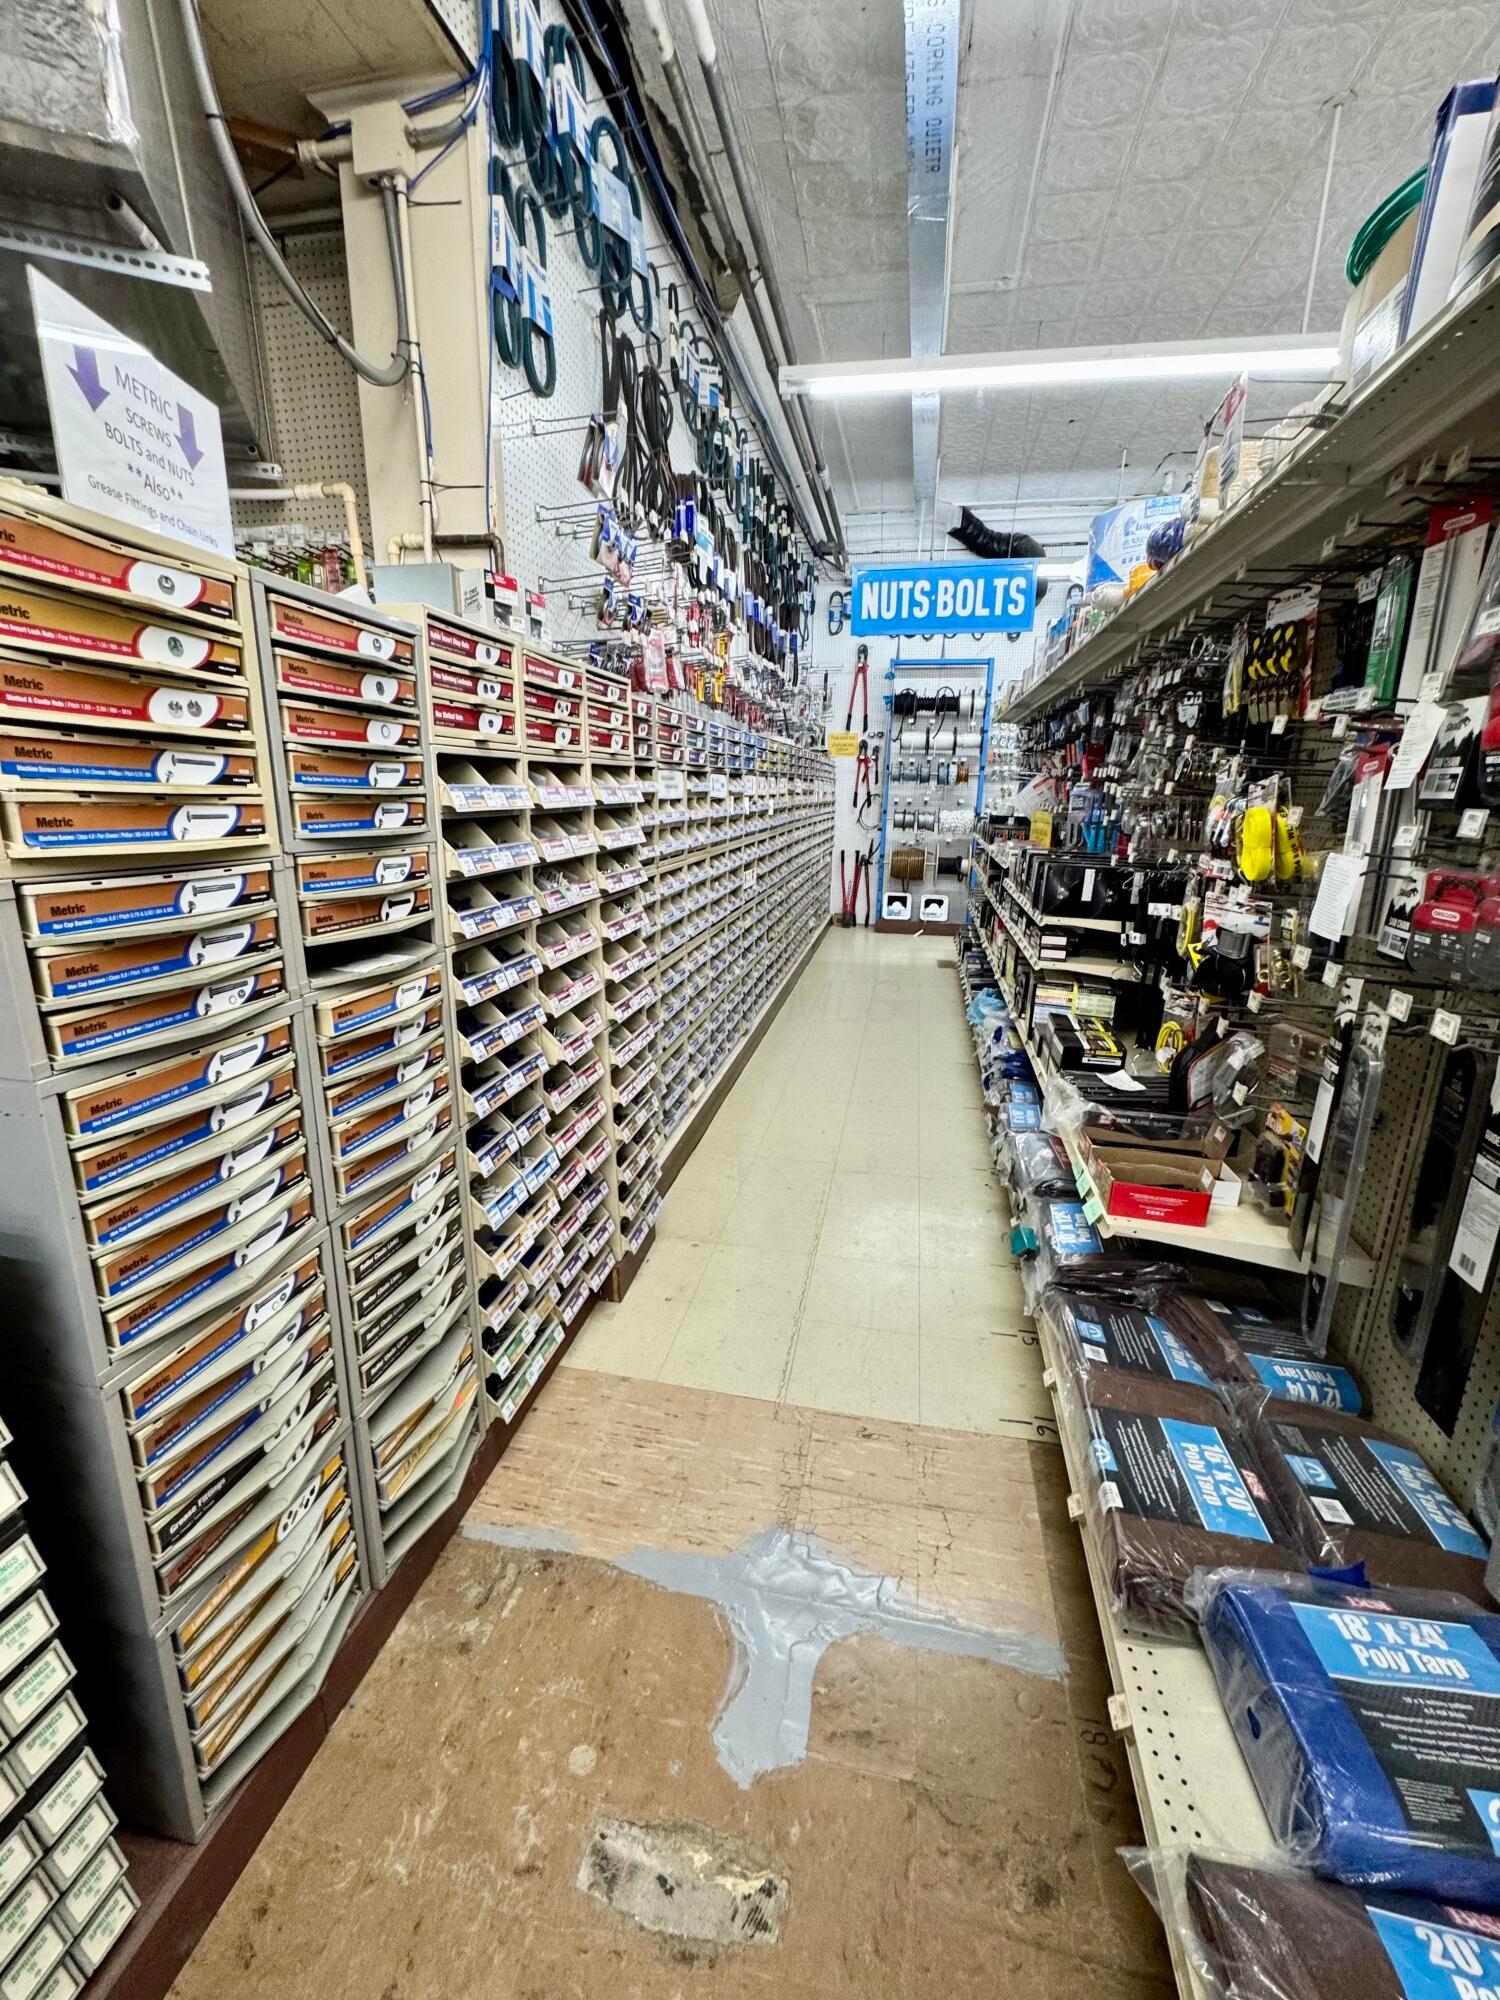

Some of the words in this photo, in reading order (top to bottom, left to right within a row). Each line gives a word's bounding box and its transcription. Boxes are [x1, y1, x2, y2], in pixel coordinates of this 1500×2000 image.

[114, 365, 174, 421] METRIC
[125, 407, 172, 448] SCREWS
[104, 421, 143, 457] BOLTS
[145, 450, 166, 470] and
[168, 459, 195, 487] NUTS
[88, 475, 123, 502] Grease
[124, 493, 159, 519] Fittings
[159, 511, 175, 528] and
[176, 519, 199, 539] Chain
[199, 530, 219, 548] Links
[861, 580, 931, 620] NUTS
[936, 576, 1027, 618] BOLTS
[0, 603, 30, 619] etric
[283, 611, 304, 626] Metric
[288, 663, 308, 675] Metric
[4, 674, 44, 691] Metric
[295, 714, 315, 725] Metric
[14, 746, 53, 760] Metric
[301, 763, 318, 772] Metric
[36, 817, 73, 829] Metric
[306, 812, 324, 820] Metric
[309, 871, 327, 879] Metric
[50, 903, 86, 917] Metric
[315, 914, 334, 924] Metric
[1433, 910, 1458, 920] OREGON
[65, 963, 99, 978] Metric
[73, 1021, 108, 1037] Metric
[90, 1098, 122, 1116] Metric
[96, 1151, 128, 1171] Metric
[108, 1205, 139, 1227] Metric
[374, 1246, 387, 1262] Chain
[387, 1236, 400, 1252] Links
[118, 1254, 149, 1276] Metric
[376, 1281, 390, 1297] Chain
[128, 1302, 157, 1325] Metric
[380, 1313, 393, 1329] Chain
[1273, 1364, 1308, 1382] Tarp
[1304, 1369, 1336, 1386] Poly
[143, 1374, 171, 1399] Metric
[1306, 1384, 1320, 1402] X
[1322, 1387, 1343, 1409] 12'
[154, 1422, 181, 1446] Metric
[1200, 1444, 1230, 1470] 16'
[164, 1462, 191, 1488] Metric
[1180, 1441, 1208, 1474] Poly
[1200, 1471, 1223, 1507] Tarp
[1215, 1469, 1236, 1483] X
[1218, 1482, 1257, 1519] 20'
[1389, 1460, 1425, 1491] Poly
[1415, 1491, 1452, 1527] Tarp
[168, 1497, 197, 1535] Grease
[197, 1477, 226, 1509] Fittings
[1328, 1612, 1373, 1643] 18'
[1376, 1620, 1407, 1646] X
[1398, 1620, 1450, 1651] 24'
[1351, 1643, 1411, 1674] Poly
[1404, 1648, 1471, 1681] Tarp
[12, 1659, 52, 1701] SPRINGS
[26, 1709, 64, 1751] SPRINGS
[47, 1768, 84, 1812] SPRINGS
[60, 1813, 96, 1857] SPRINGS
[73, 1857, 107, 1901] SPRINGS
[88, 1896, 120, 1943] SPRINGS
[10, 1934, 48, 1984] SPRINGS
[1414, 1925, 1484, 1977] 20'
